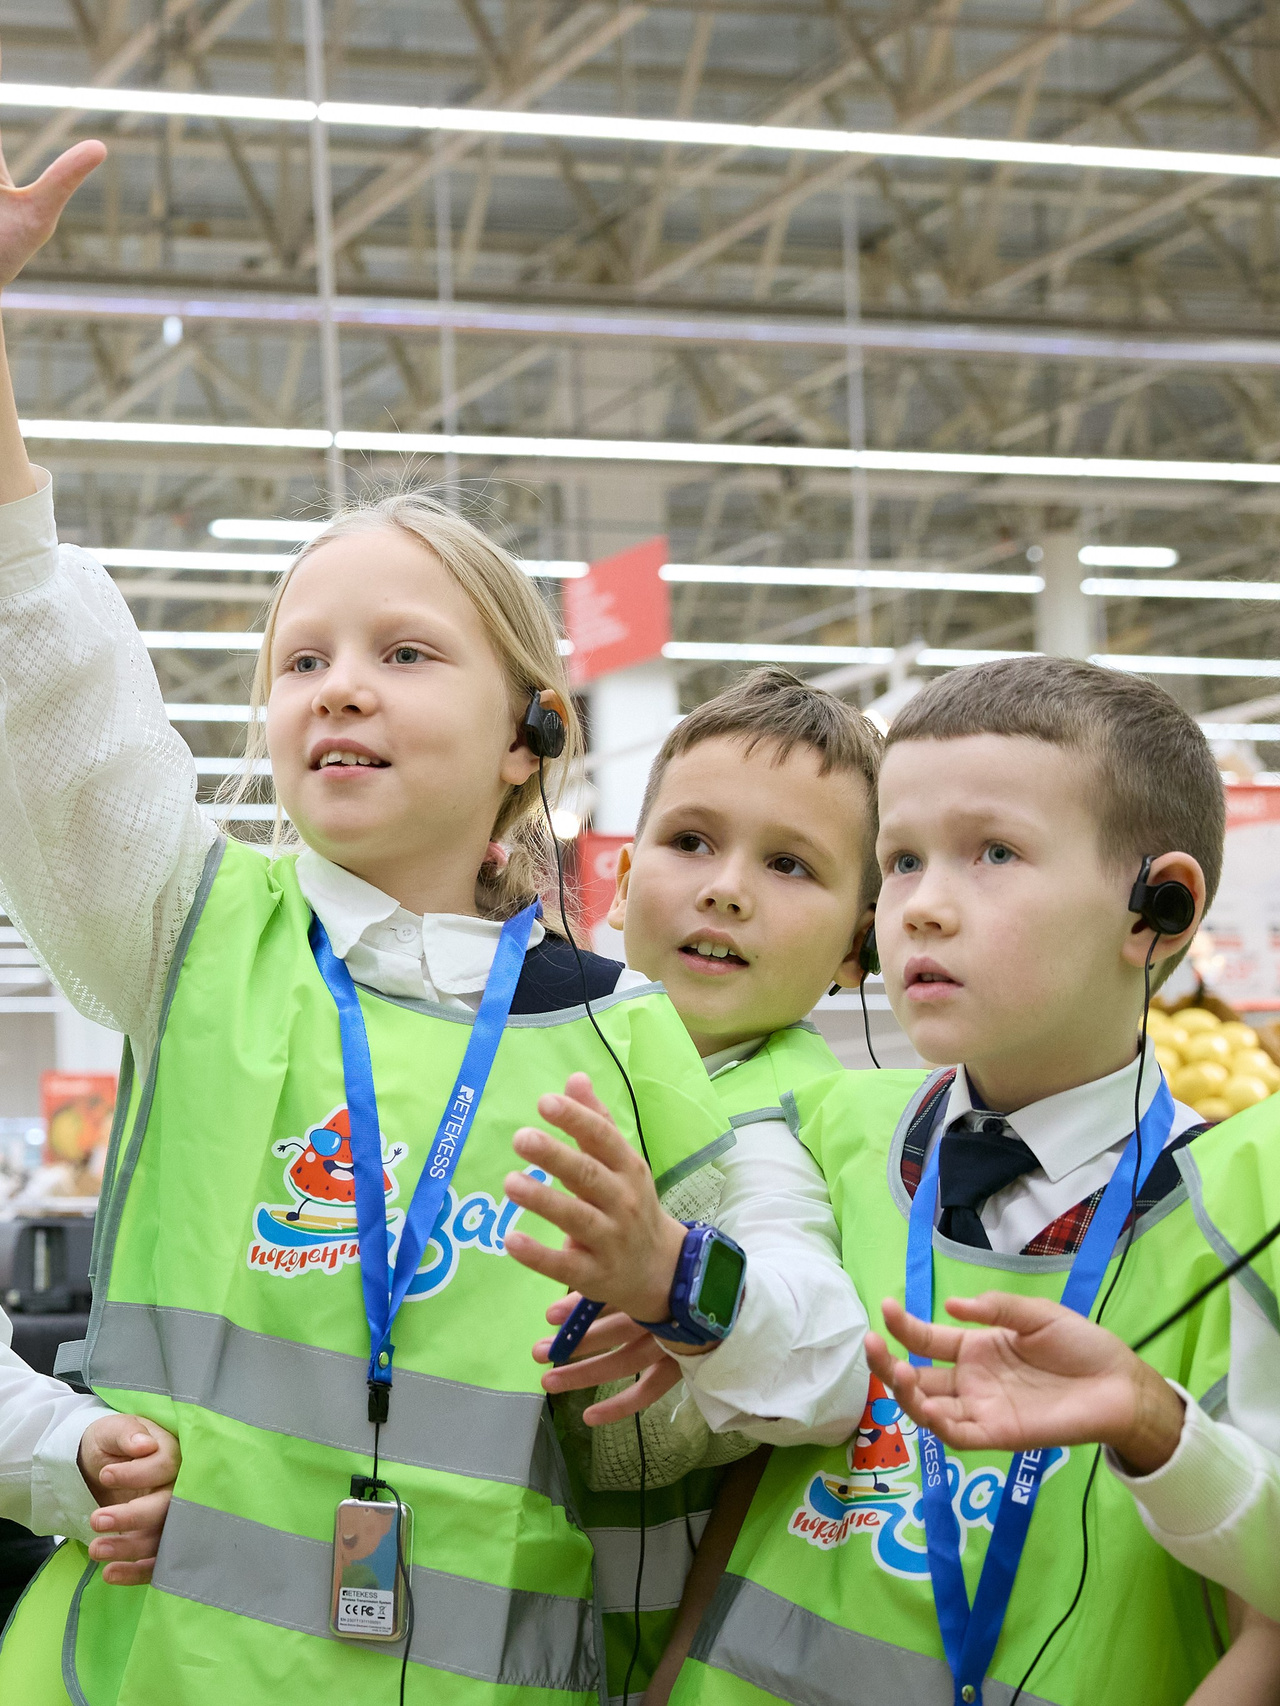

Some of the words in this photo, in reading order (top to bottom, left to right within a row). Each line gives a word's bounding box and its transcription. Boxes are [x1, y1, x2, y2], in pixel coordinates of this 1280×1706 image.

[429, 1084, 475, 1180] RETEKESS
[251, 1243, 360, 1272] поколени
[922, 1427, 940, 1488] EKESS
[1011, 1448, 1042, 1505] RETE
[342, 1590, 378, 1599] RETEKESS
